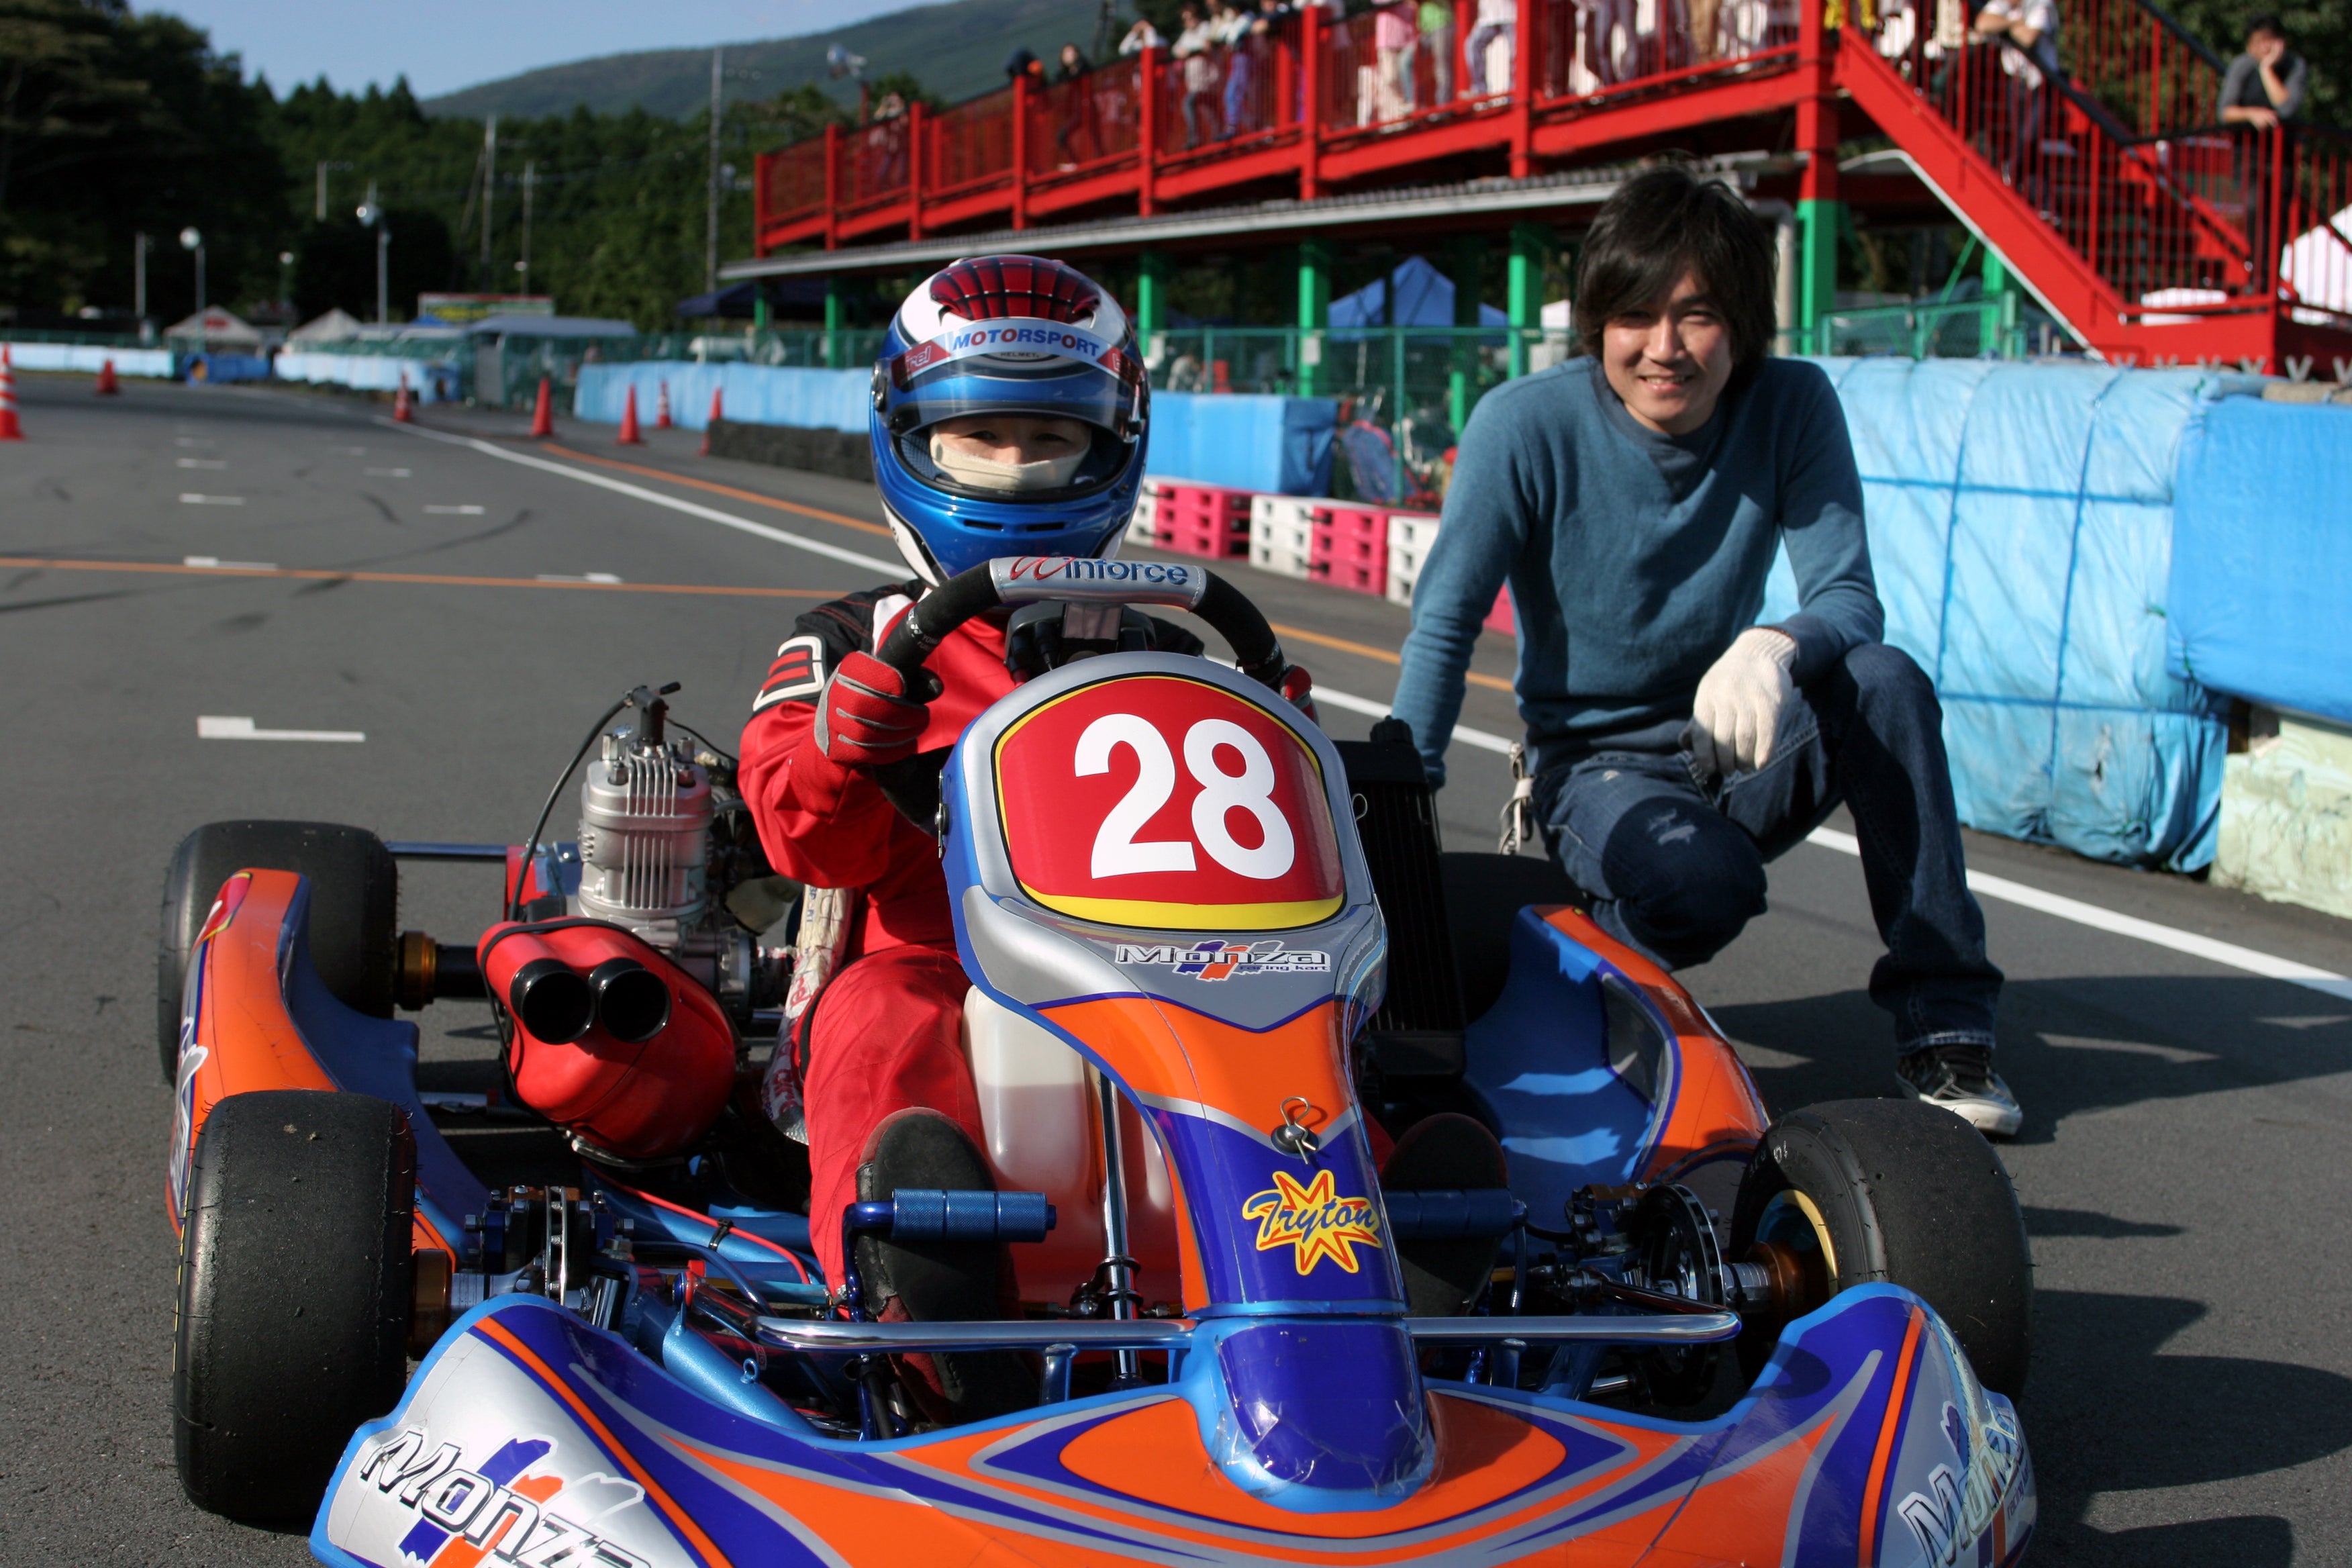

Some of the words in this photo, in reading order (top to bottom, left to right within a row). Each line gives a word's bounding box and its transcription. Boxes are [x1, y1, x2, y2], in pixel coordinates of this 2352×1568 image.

[952, 328, 1100, 357] MOTORSPORT
[1009, 555, 1188, 585] Winforce
[1074, 714, 1295, 879] 28
[1117, 944, 1328, 965] Monza
[1247, 1193, 1376, 1244] Tryton
